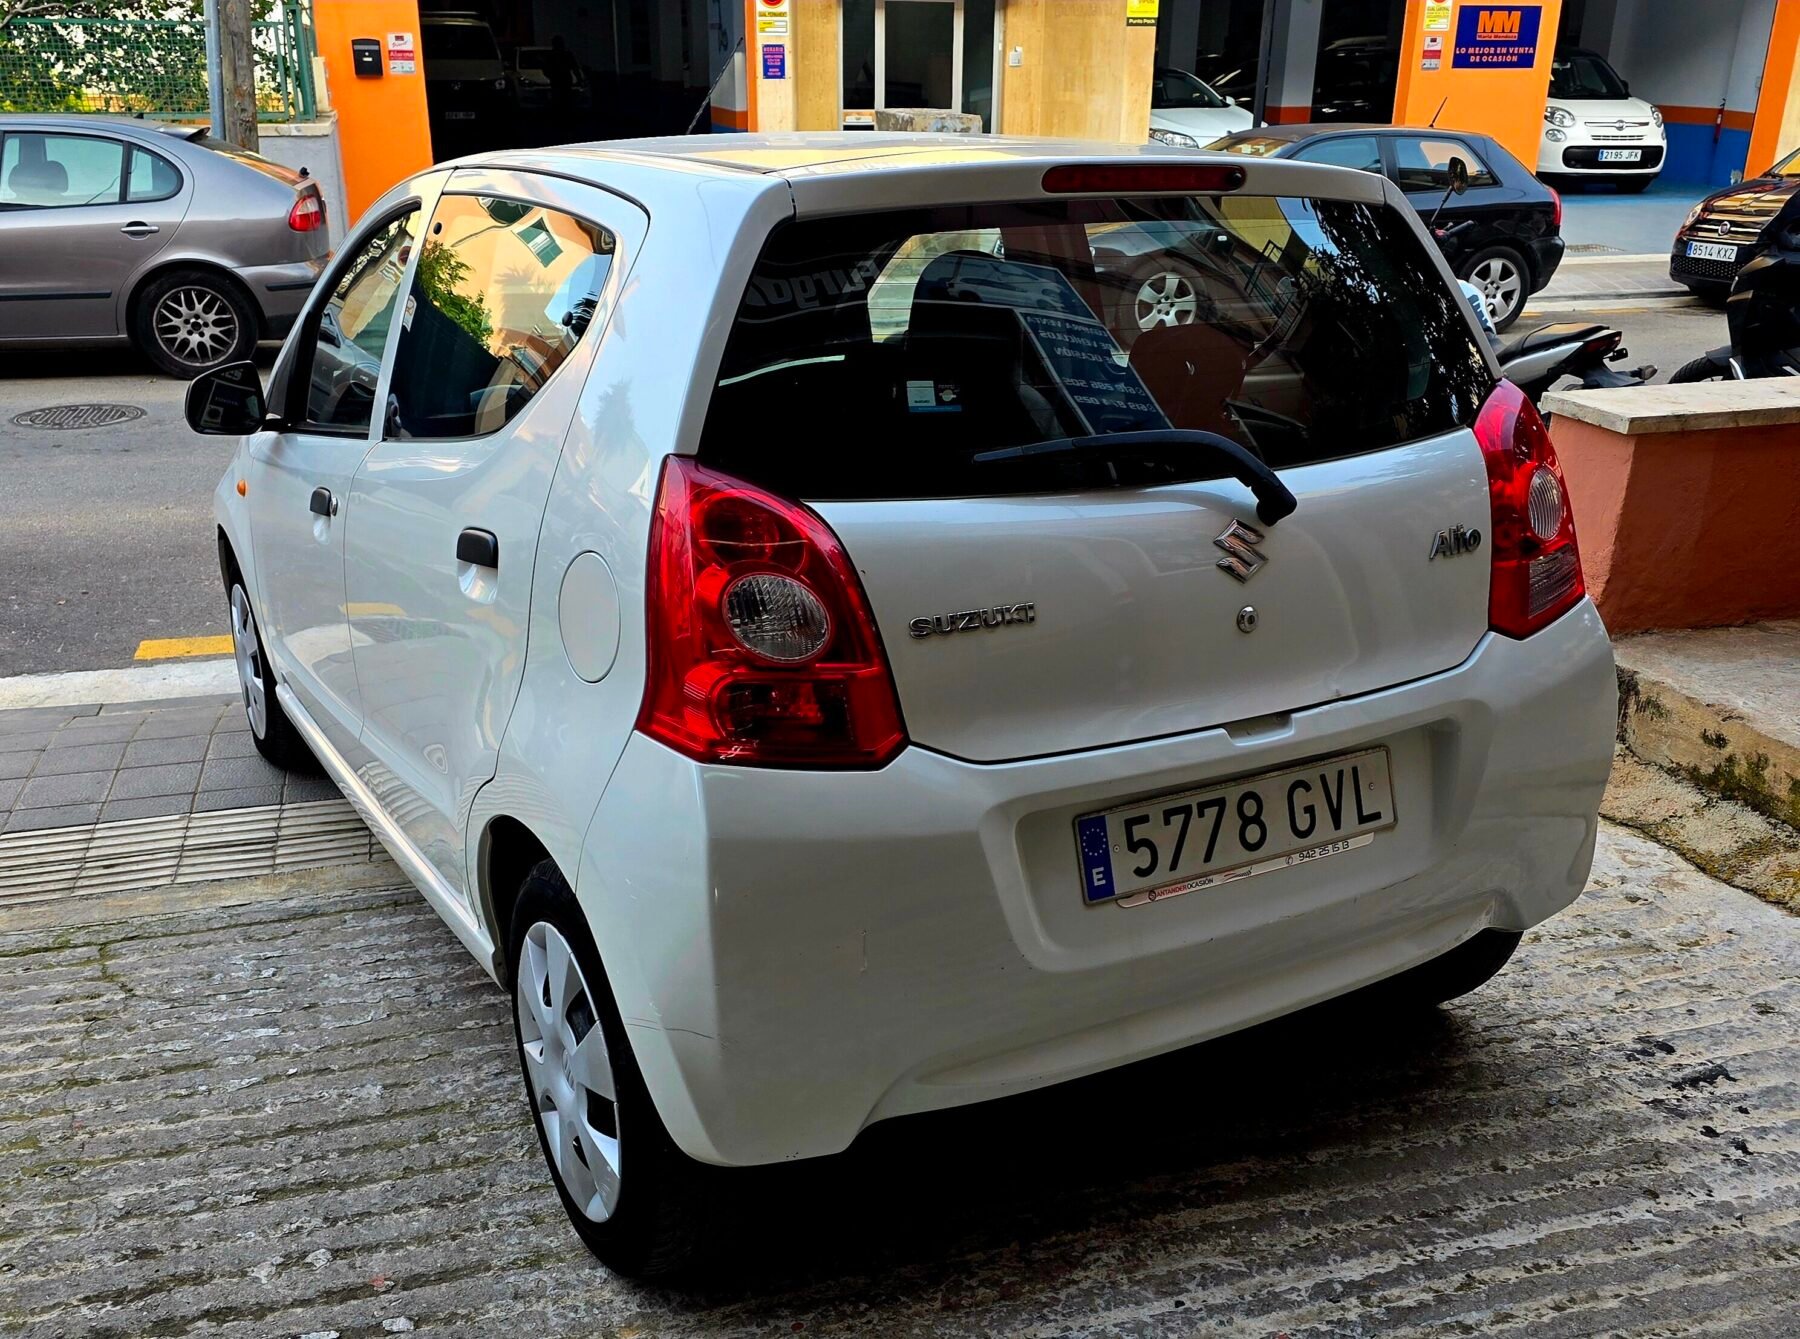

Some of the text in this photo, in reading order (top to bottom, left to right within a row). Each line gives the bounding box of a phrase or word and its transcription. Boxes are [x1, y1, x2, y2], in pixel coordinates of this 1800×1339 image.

[1477, 10, 1521, 33] MM
[1604, 151, 1639, 160] 2195 JFK
[1692, 242, 1736, 261] 8514 KXZ
[1429, 523, 1482, 560] Alto
[909, 602, 1036, 639] SUZUKI
[1123, 765, 1383, 879] 5778 GVL
[1298, 850, 1317, 862] 942
[1341, 841, 1350, 851] 13
[1092, 866, 1106, 887] E
